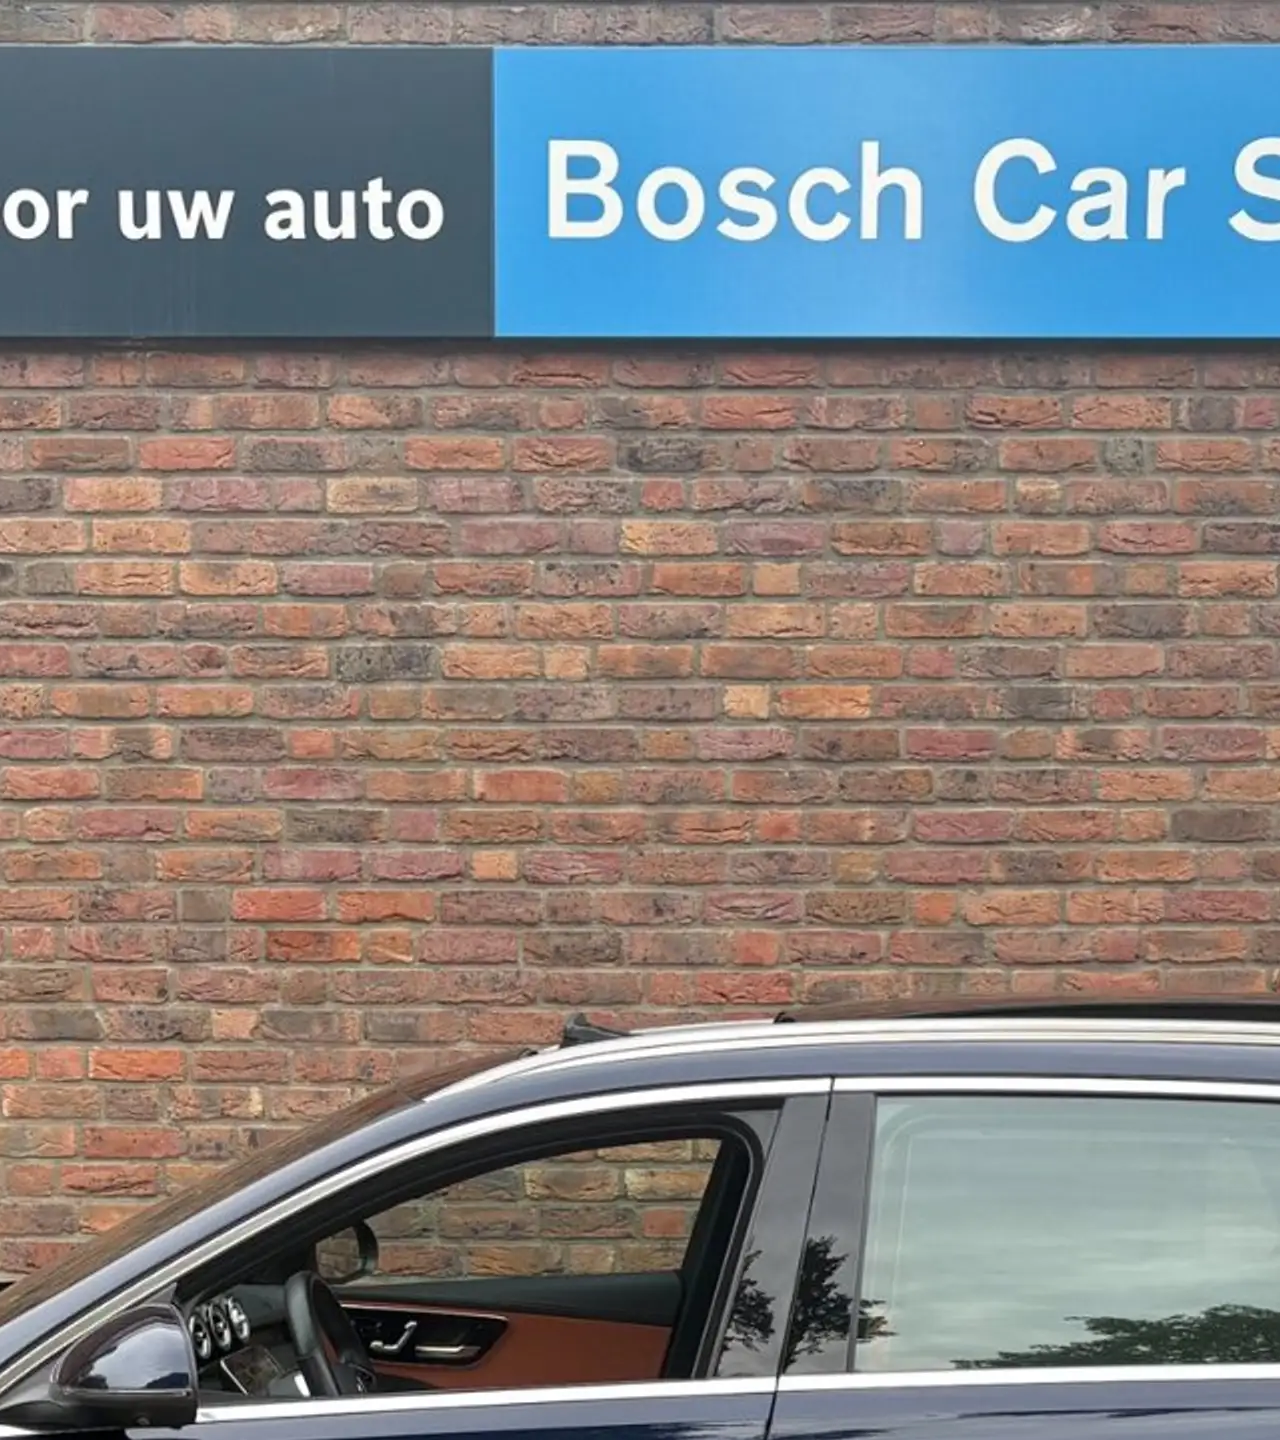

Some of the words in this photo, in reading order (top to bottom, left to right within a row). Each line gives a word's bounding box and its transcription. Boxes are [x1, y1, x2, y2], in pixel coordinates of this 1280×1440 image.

[117, 189, 236, 241] uw
[263, 176, 445, 242] auto
[547, 137, 924, 243] Bosch
[973, 137, 1187, 243] Car
